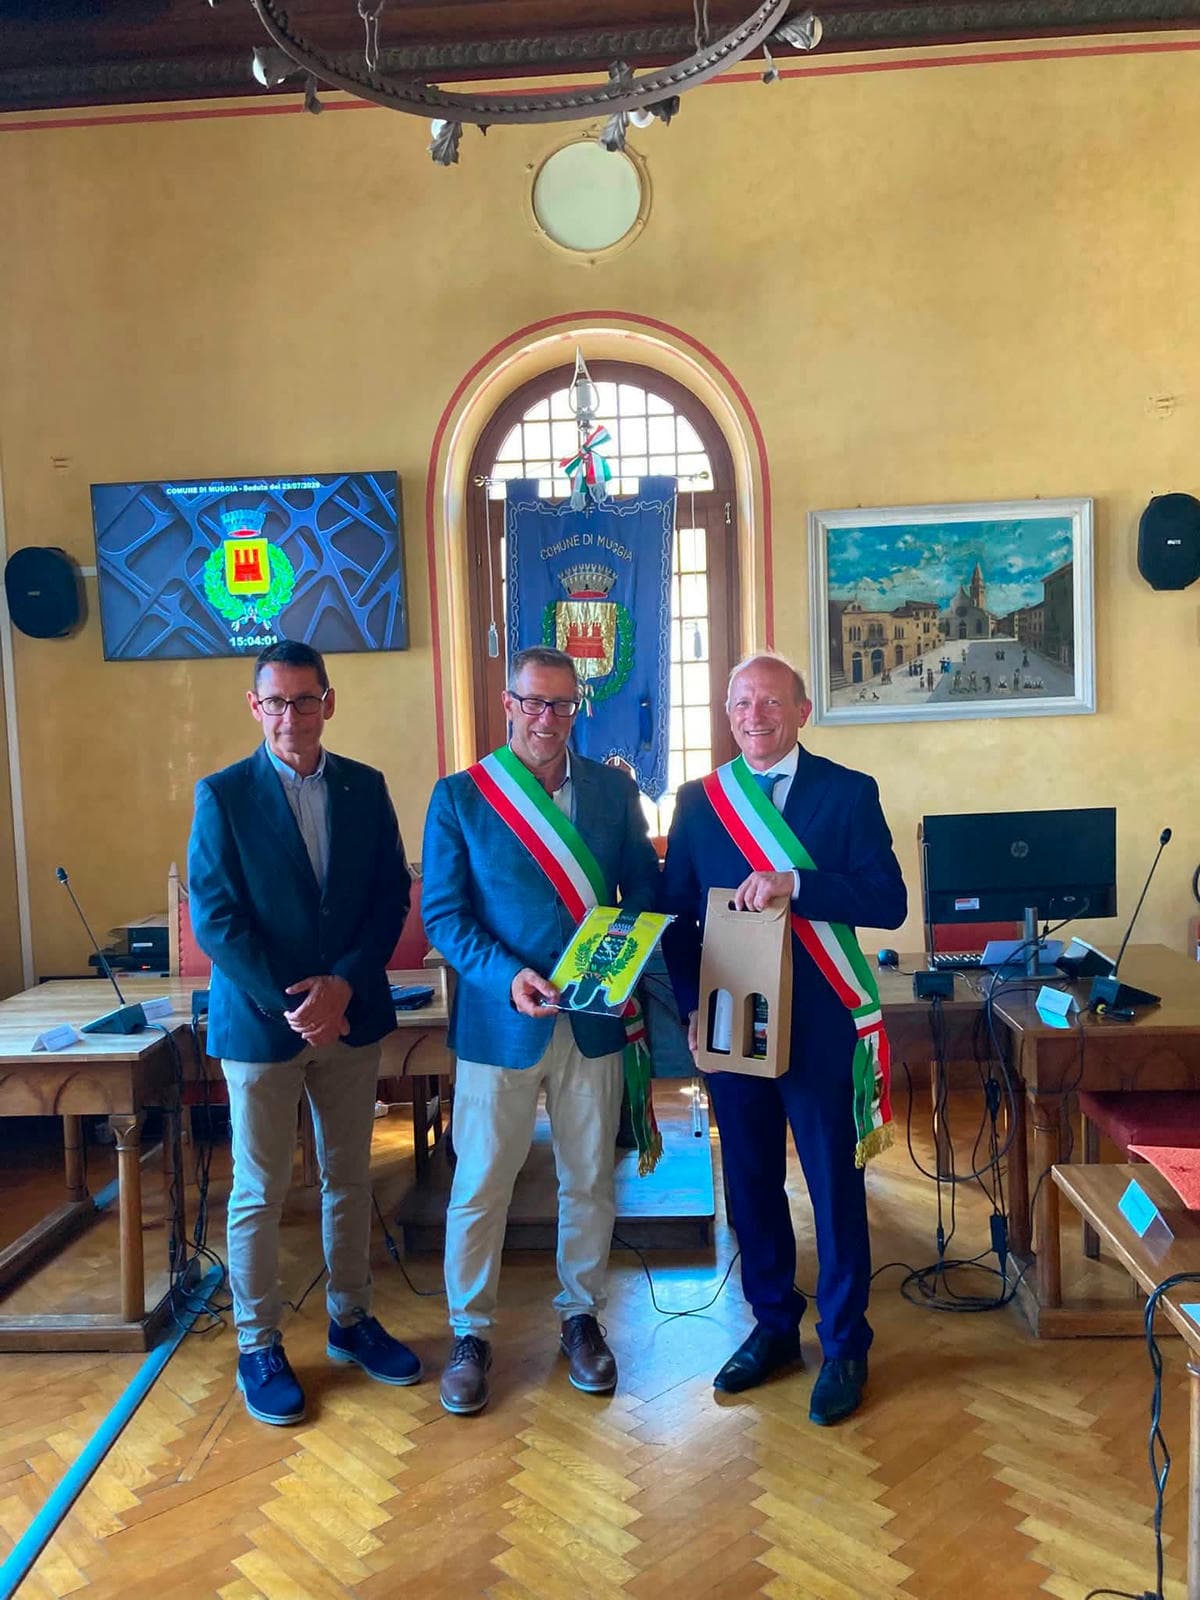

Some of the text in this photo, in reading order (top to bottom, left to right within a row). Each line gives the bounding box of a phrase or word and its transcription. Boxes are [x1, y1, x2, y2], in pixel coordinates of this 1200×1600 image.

[166, 487, 198, 495] COMUNE
[208, 485, 238, 493] MUGGIA
[540, 533, 633, 561] COMUNE DI MUGGIA
[229, 635, 278, 647] 15:04:01
